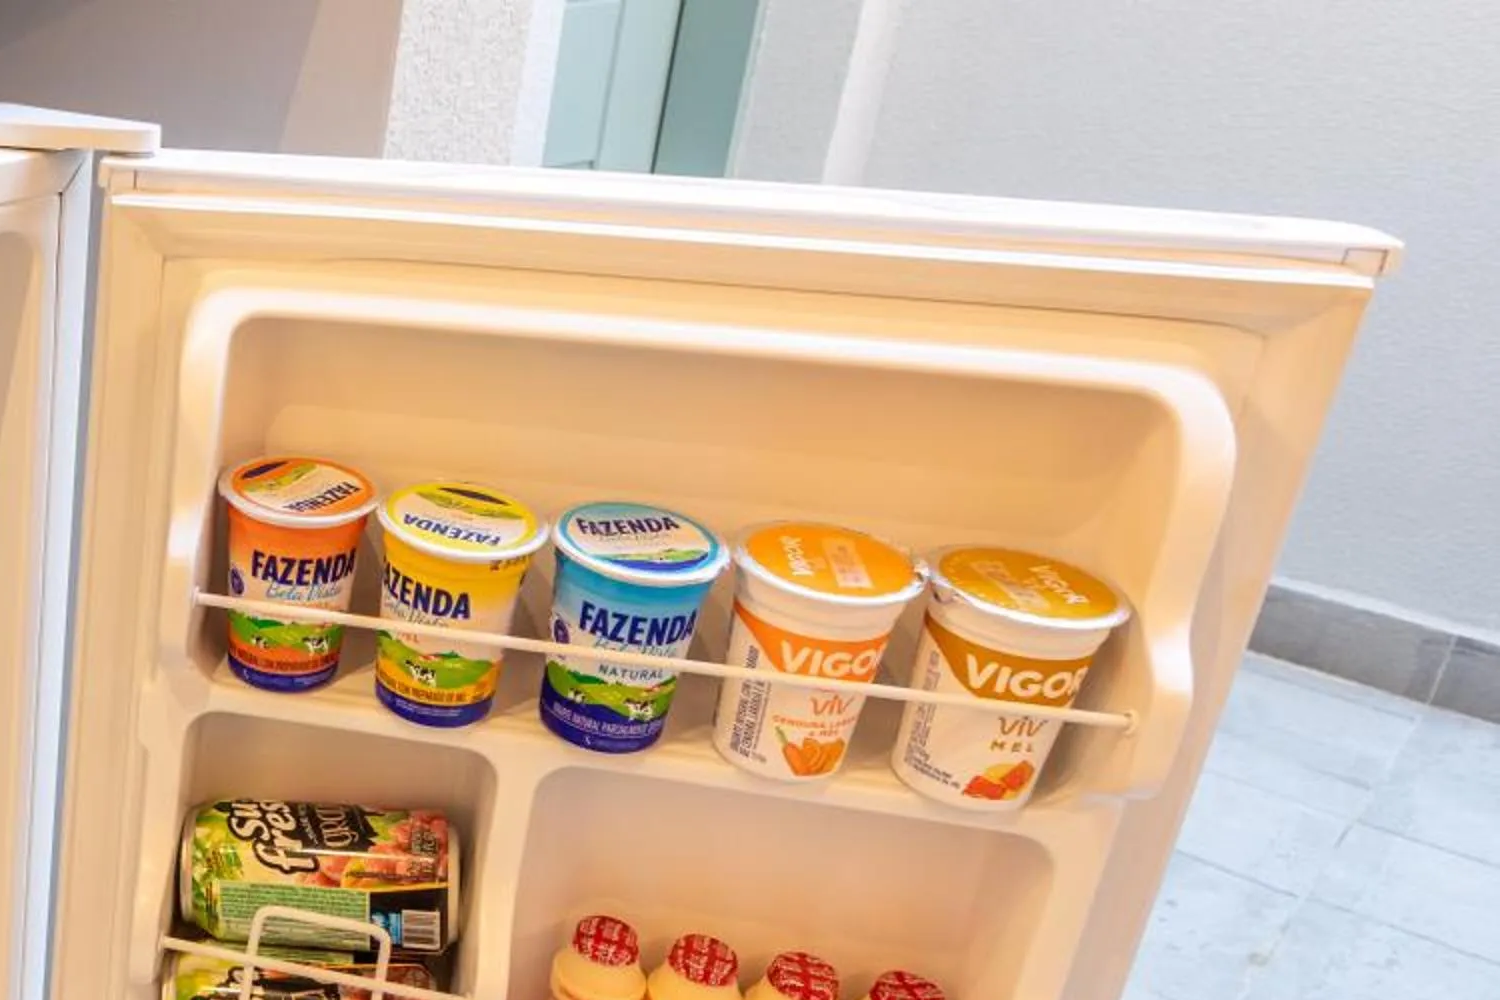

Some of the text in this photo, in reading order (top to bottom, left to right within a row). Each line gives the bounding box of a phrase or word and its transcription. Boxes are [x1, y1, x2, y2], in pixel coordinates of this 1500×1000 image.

[403, 513, 500, 546] FAZENDA
[575, 516, 680, 537] FAZENDA
[251, 548, 357, 587] FAZENDA
[579, 600, 697, 646] FAZENDA
[598, 664, 664, 681] NATURAL
[990, 741, 1035, 753] MEL
[253, 800, 320, 873] fres
